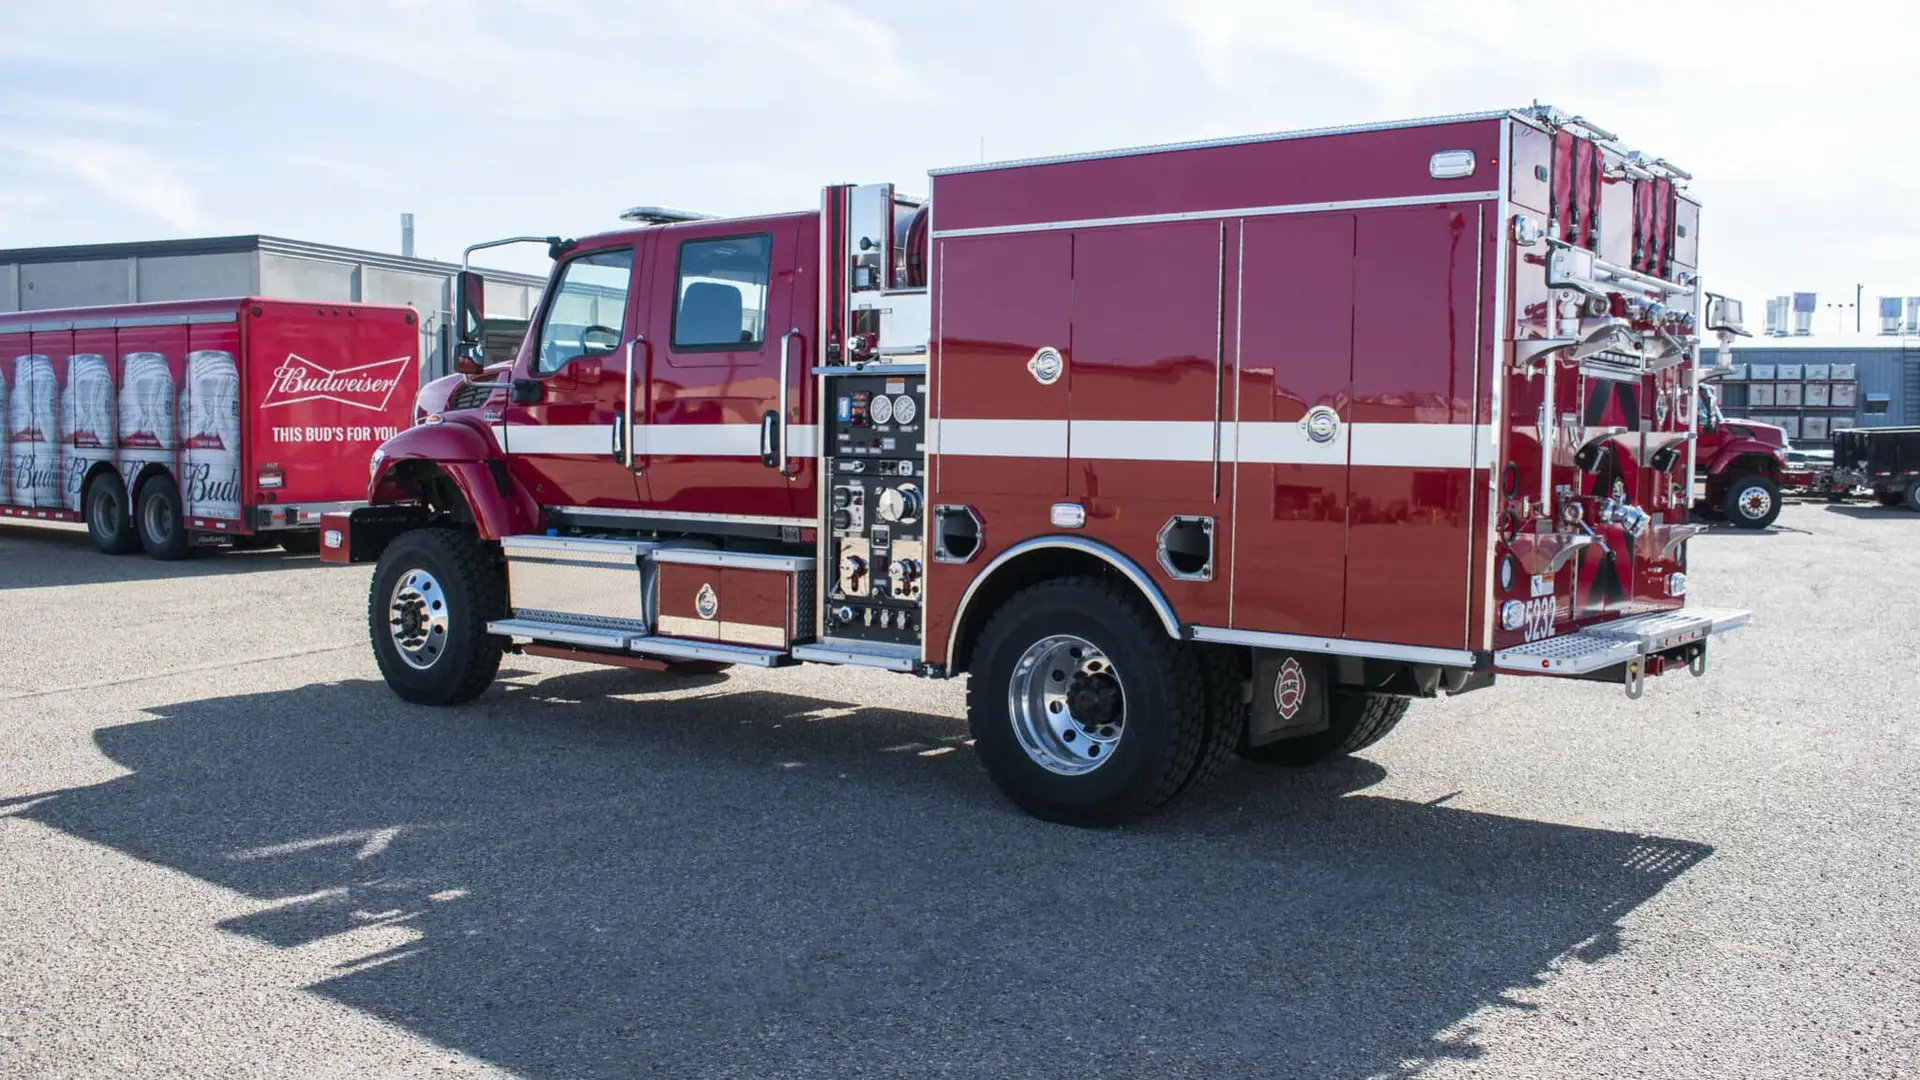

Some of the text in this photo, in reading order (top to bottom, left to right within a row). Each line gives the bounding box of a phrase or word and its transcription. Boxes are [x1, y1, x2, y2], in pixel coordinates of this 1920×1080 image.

[274, 366, 395, 393] Budweiser
[272, 427, 397, 442] THIS BUD'S FOR YOU
[1524, 595, 1556, 643] 5232
